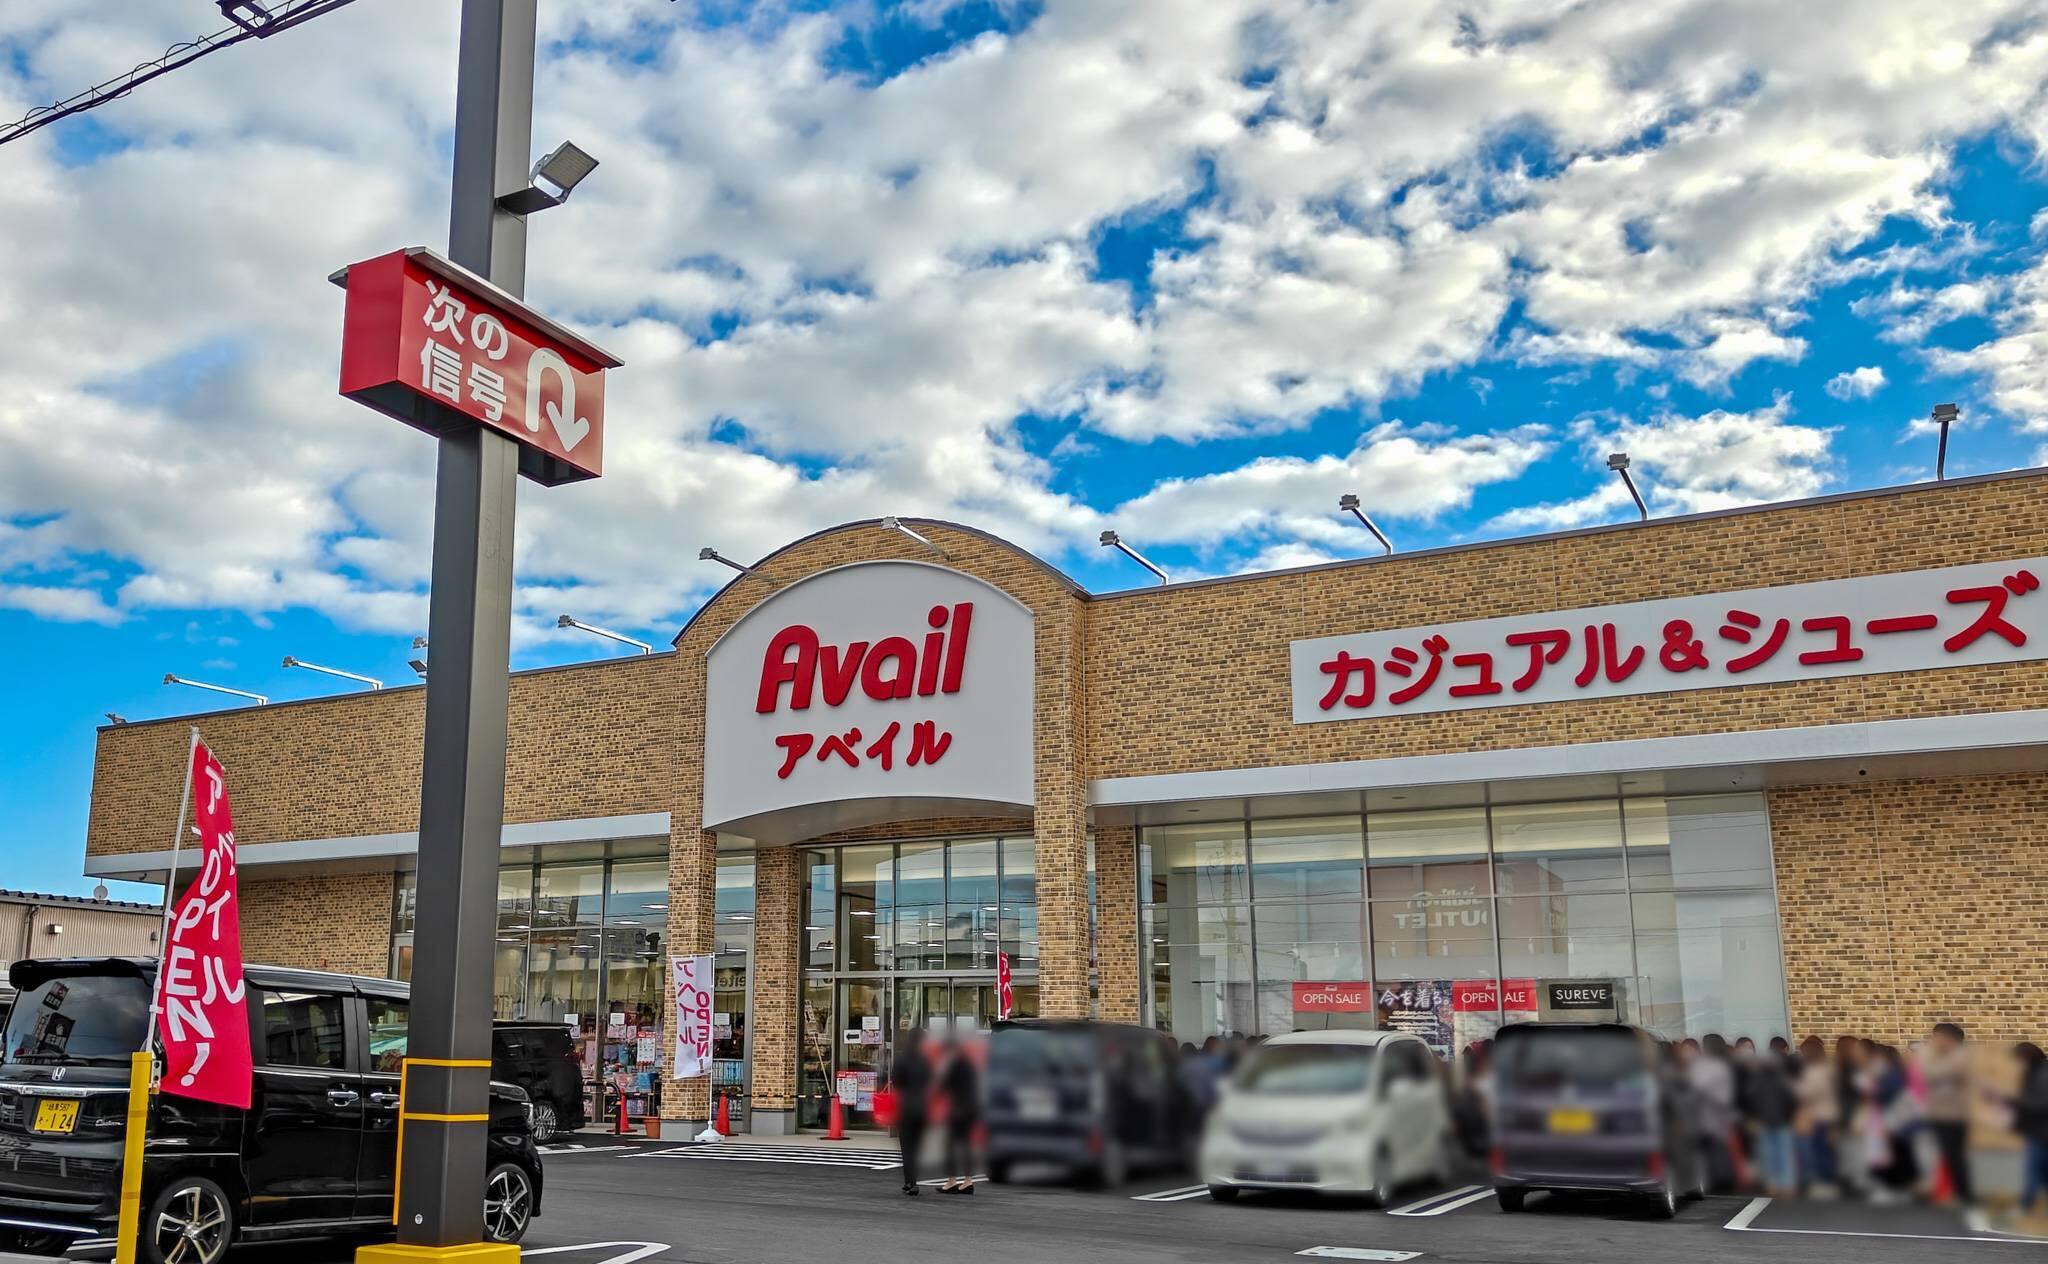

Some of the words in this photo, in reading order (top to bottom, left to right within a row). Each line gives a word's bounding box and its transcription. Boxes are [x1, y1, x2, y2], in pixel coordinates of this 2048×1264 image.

[422, 279, 509, 361] 次の
[420, 337, 507, 422] 信号
[756, 602, 974, 714] Avail
[775, 720, 953, 780] アベイル
[202, 765, 246, 1004] アベイル
[1302, 994, 1334, 1004] OPEN
[1335, 993, 1361, 1004] SALE
[1461, 992, 1495, 1004] OPEN
[1503, 991, 1526, 1003] ALE
[1556, 988, 1607, 1000] SUREVE
